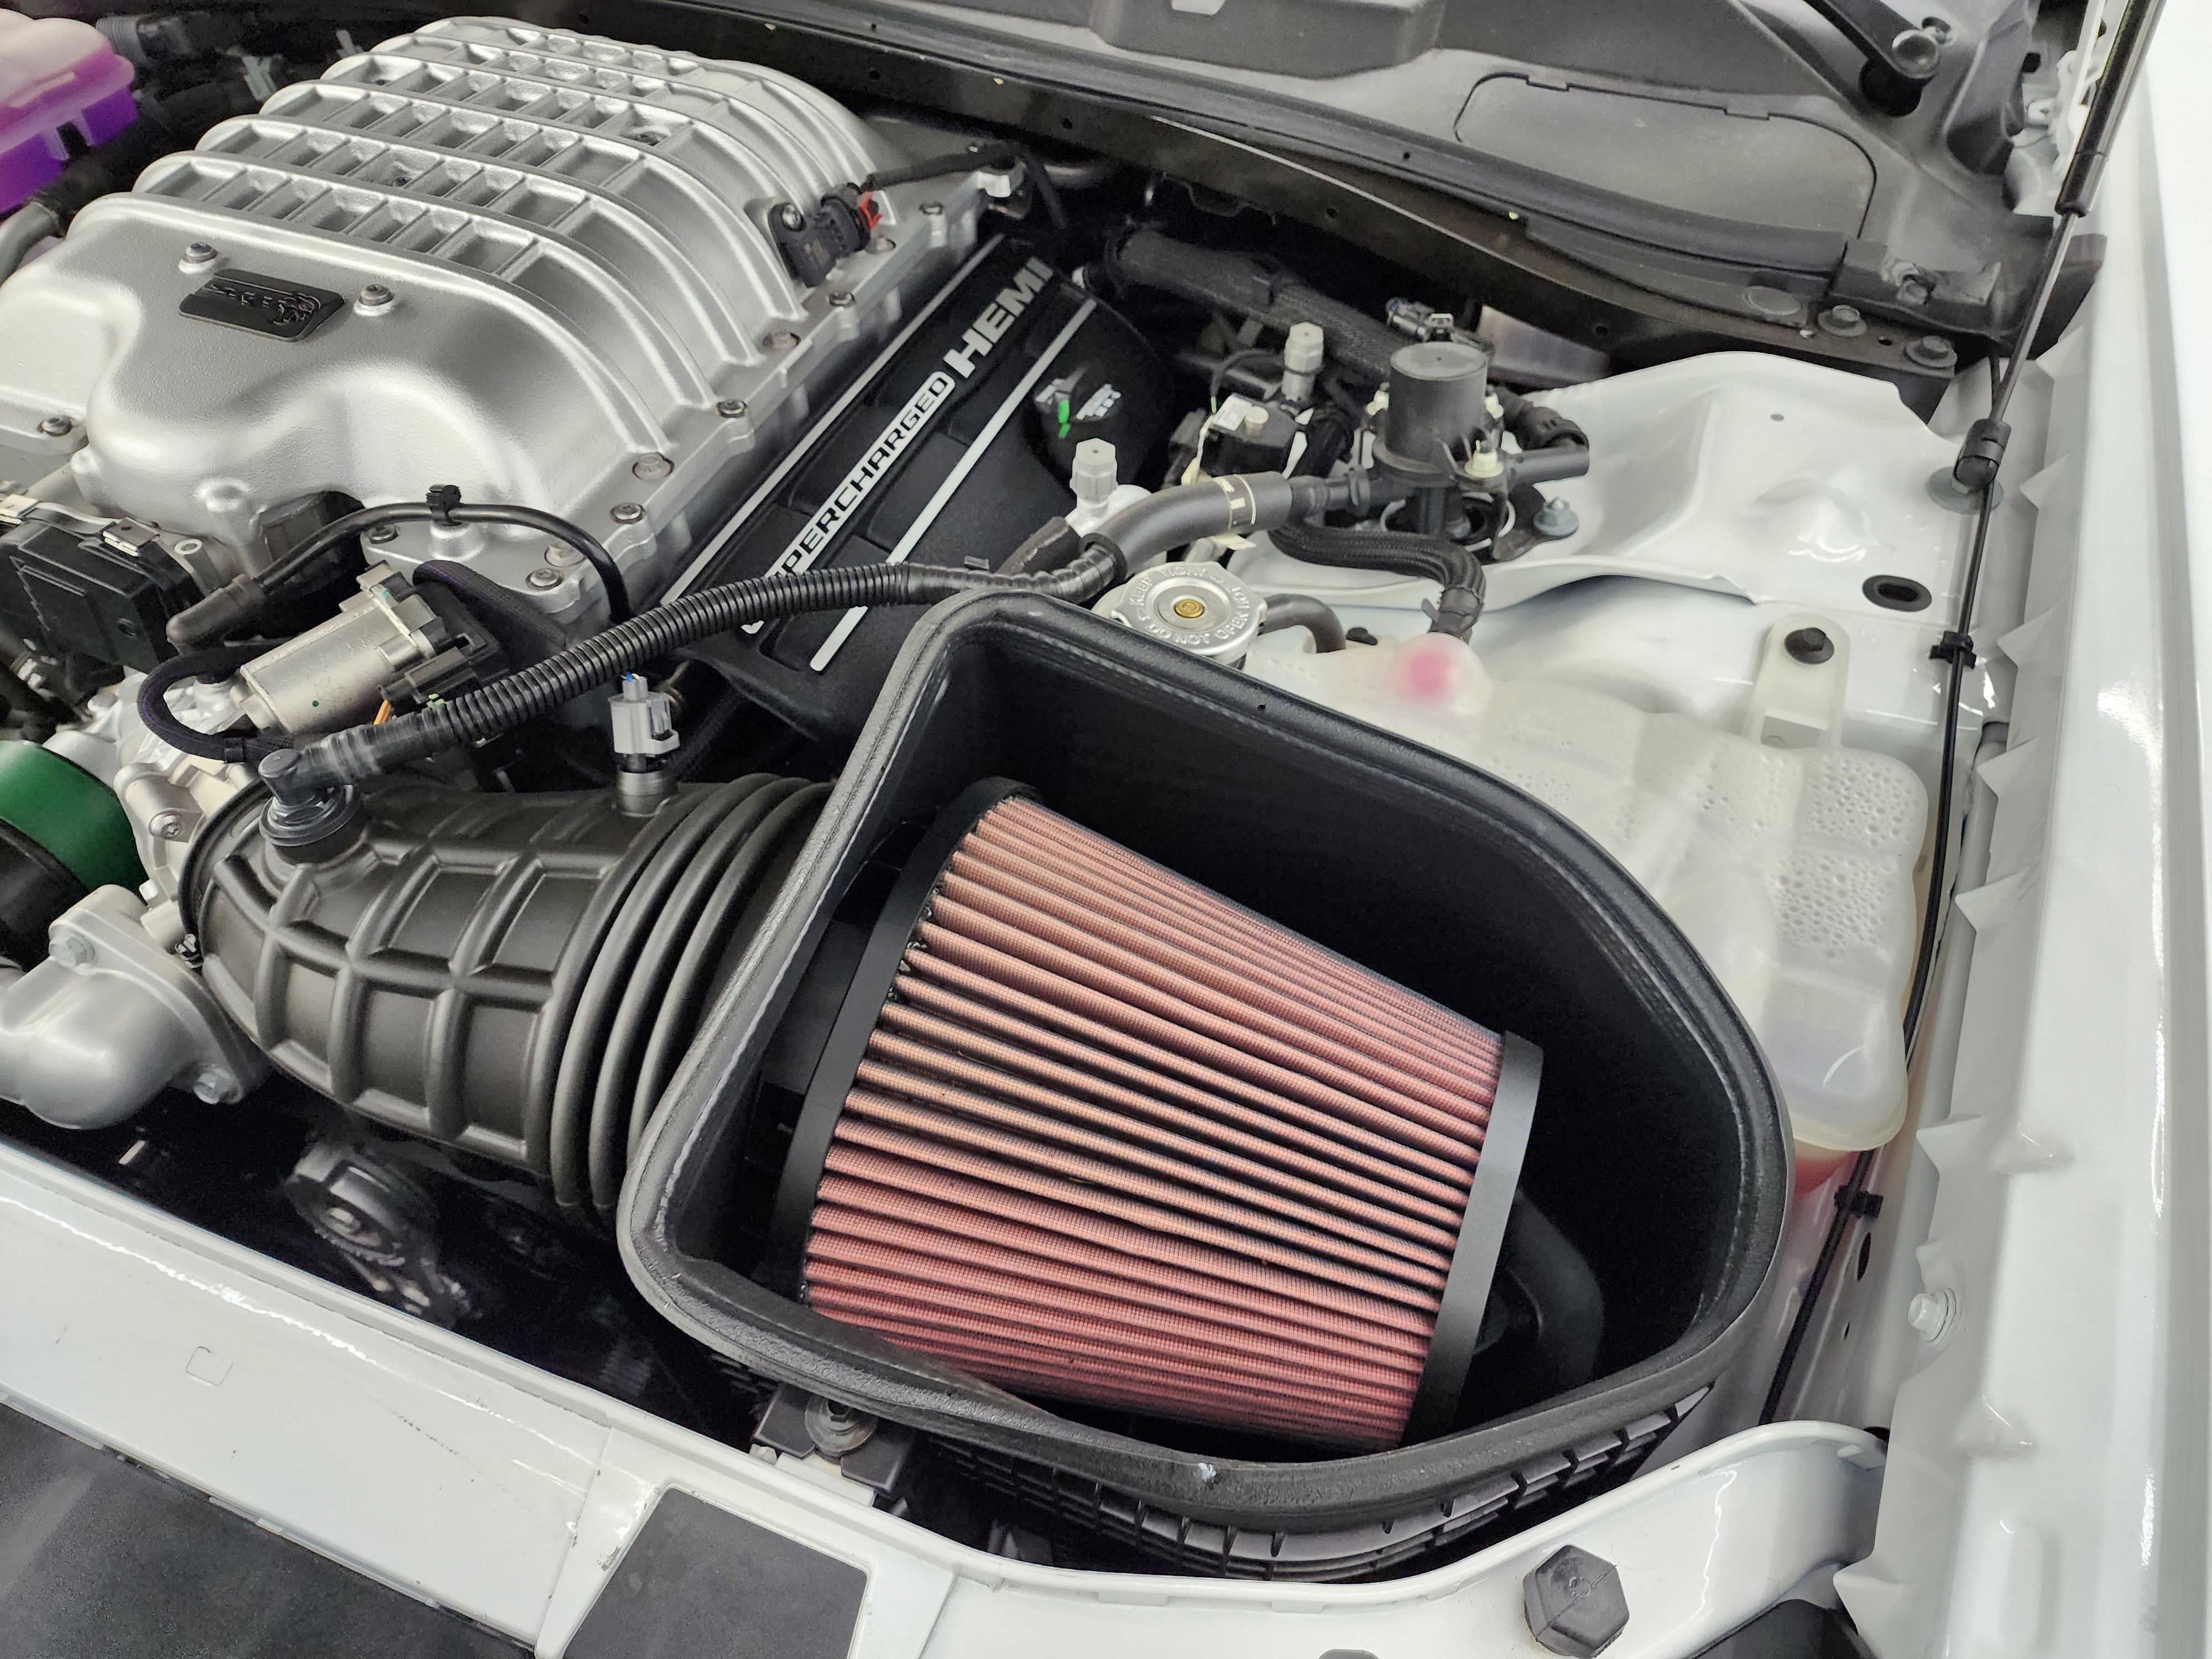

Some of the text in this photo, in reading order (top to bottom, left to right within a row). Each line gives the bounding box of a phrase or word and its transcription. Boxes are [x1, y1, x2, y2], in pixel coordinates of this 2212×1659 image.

[776, 257, 1054, 574] PERCHARGED HEMI
[1129, 566, 1208, 606] KEEP TIGHT
[1147, 624, 1172, 638] DO
[1175, 633, 1211, 644] NOT
[1215, 613, 1249, 639] OPEN
